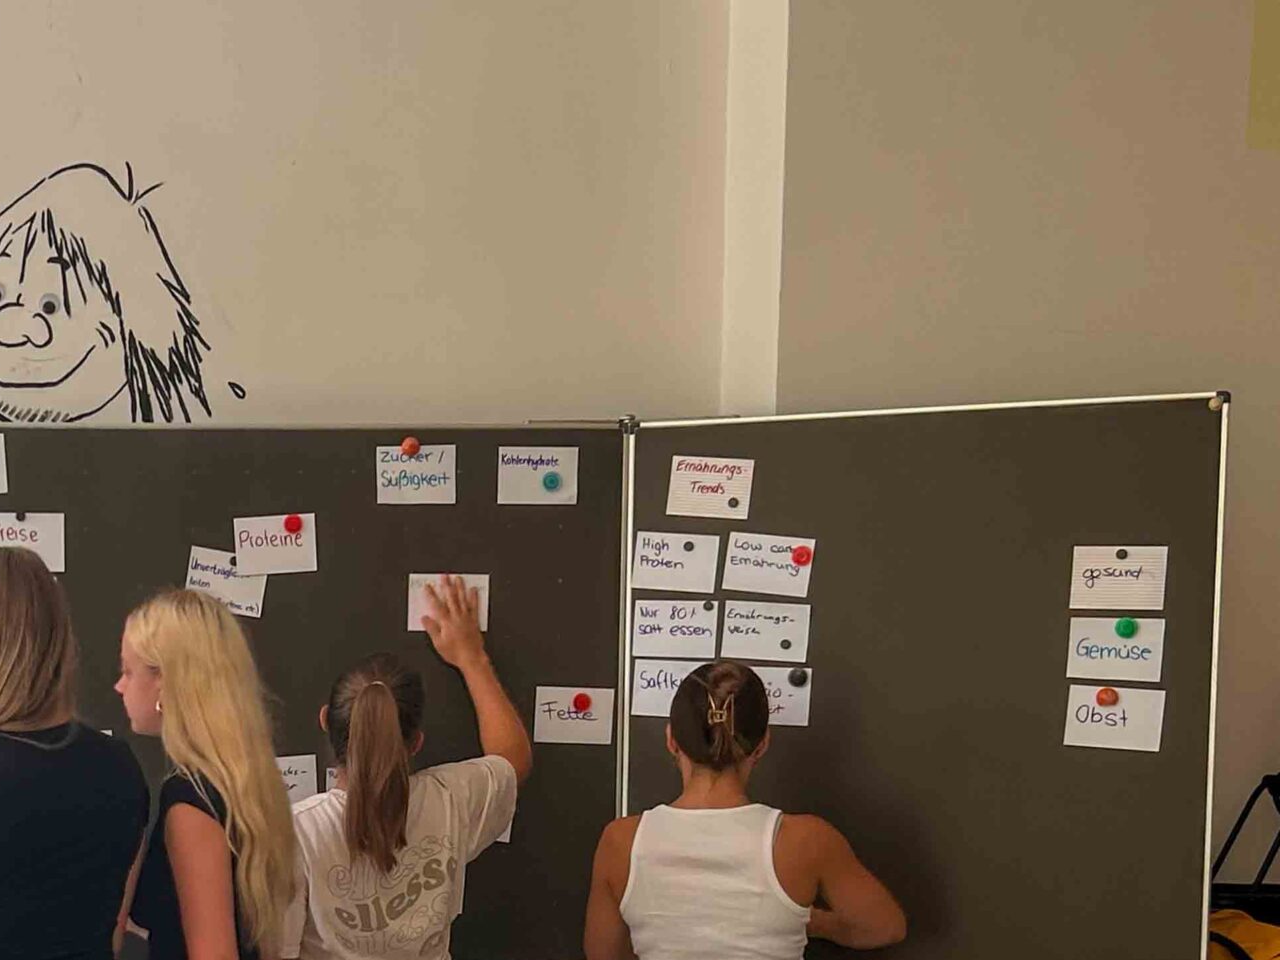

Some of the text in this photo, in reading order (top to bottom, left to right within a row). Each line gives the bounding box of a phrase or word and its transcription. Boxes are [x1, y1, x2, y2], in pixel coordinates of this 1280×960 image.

[690, 480, 726, 495] Trends
[238, 530, 303, 549] Proteine
[642, 537, 670, 557] High
[639, 606, 660, 618] Nur
[669, 625, 713, 638] essen
[1075, 637, 1153, 661] Gemüse
[540, 700, 599, 722] Fette
[1075, 704, 1129, 728] Obst
